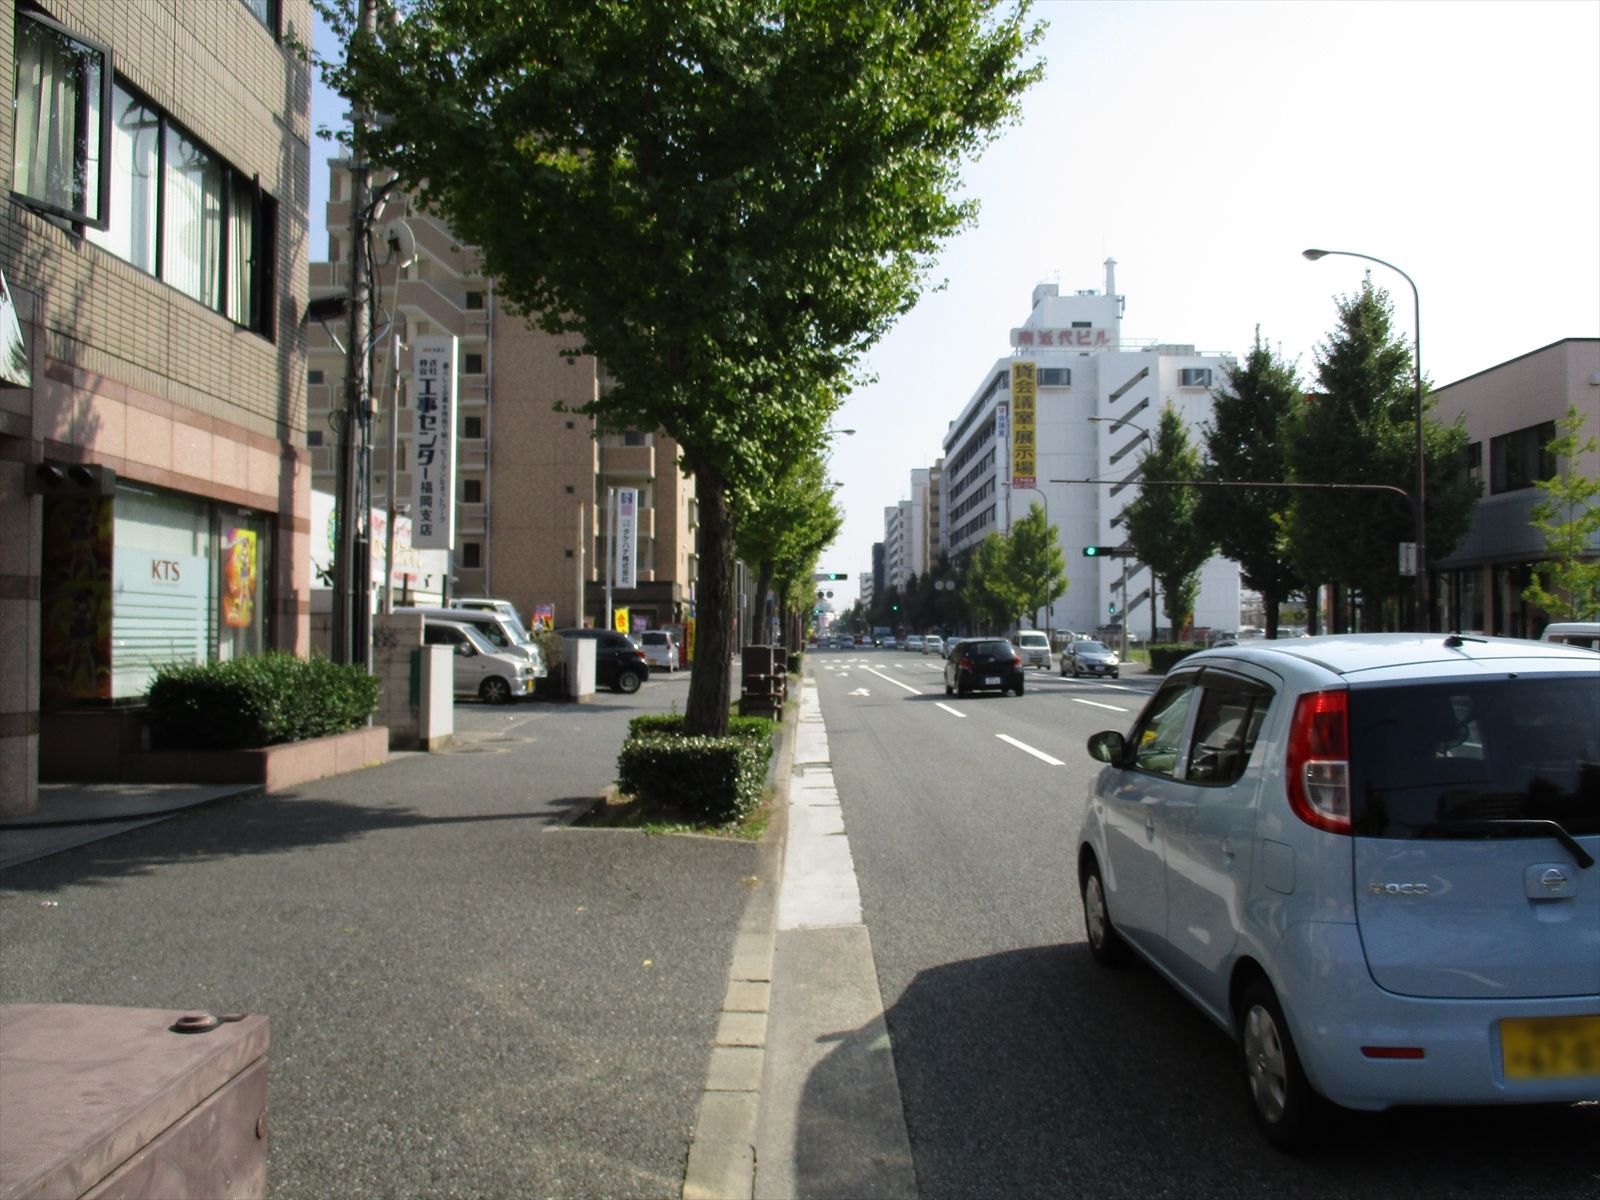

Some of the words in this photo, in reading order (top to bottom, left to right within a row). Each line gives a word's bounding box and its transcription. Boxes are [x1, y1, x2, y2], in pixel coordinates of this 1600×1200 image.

[1014, 363, 1034, 475] 貸会議室・展示場
[151, 559, 181, 582] KTS
